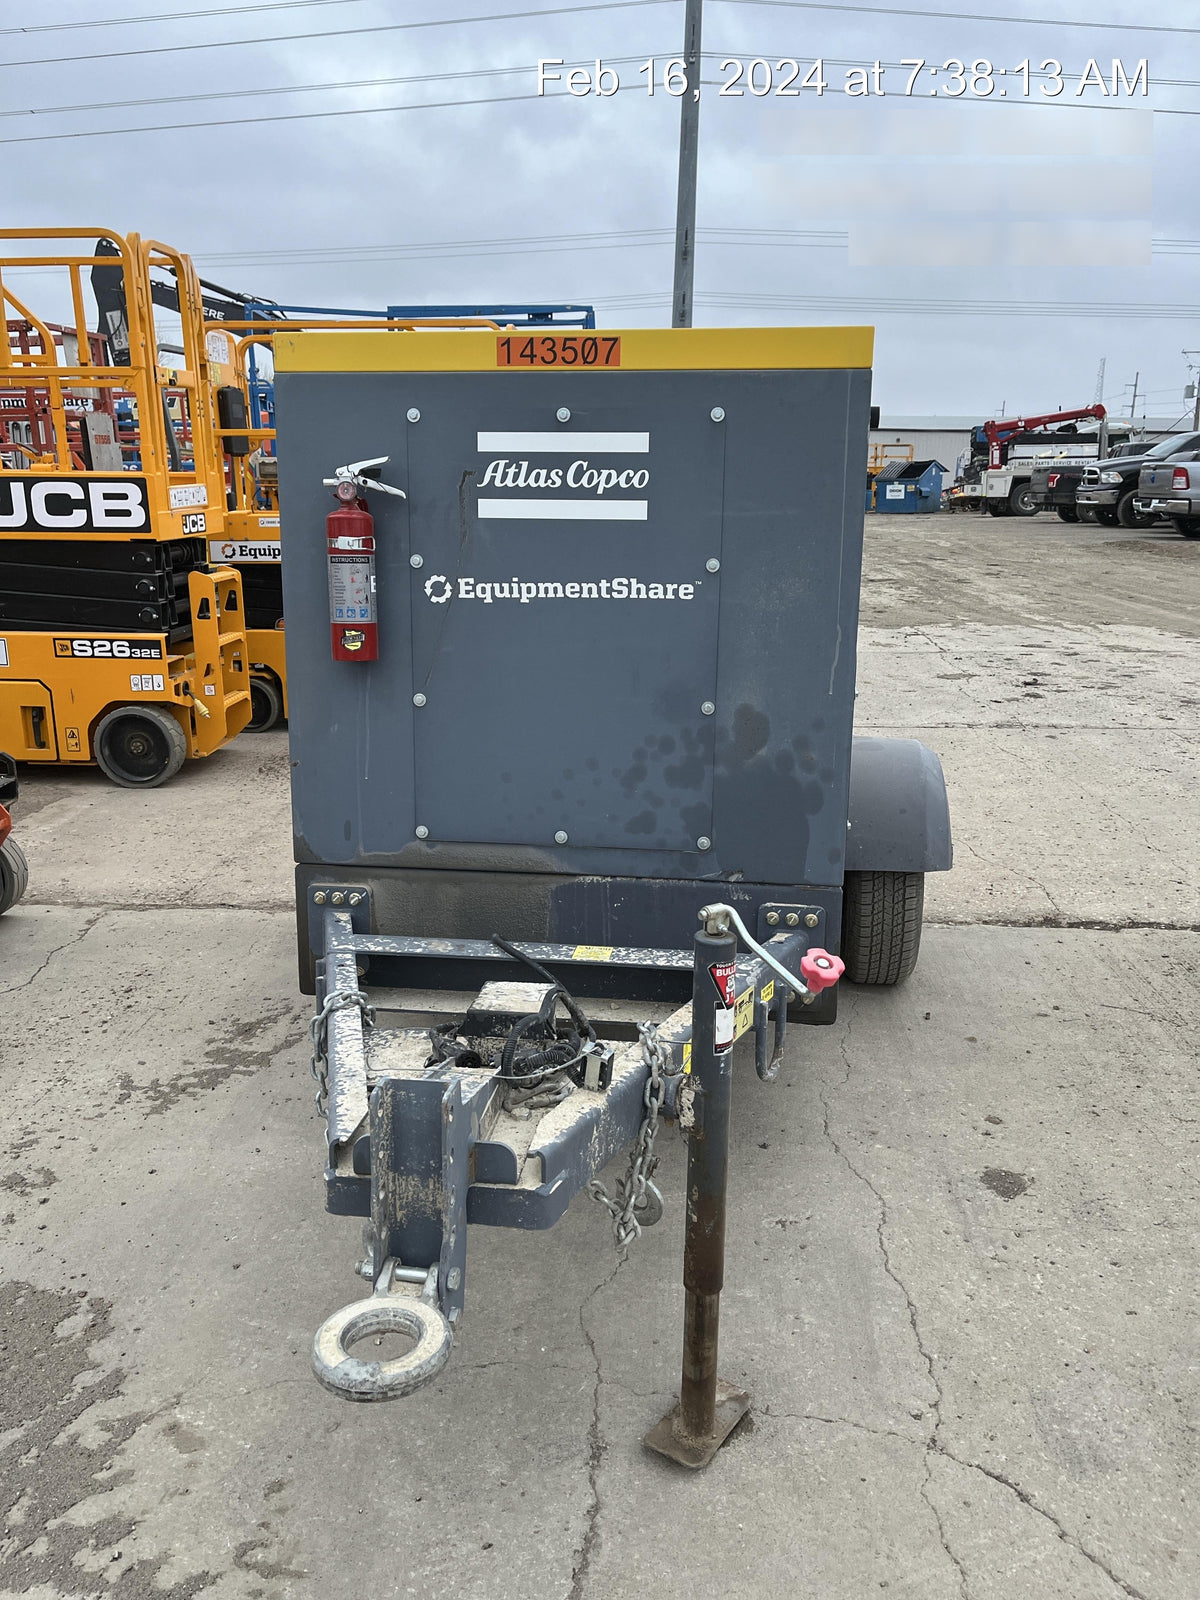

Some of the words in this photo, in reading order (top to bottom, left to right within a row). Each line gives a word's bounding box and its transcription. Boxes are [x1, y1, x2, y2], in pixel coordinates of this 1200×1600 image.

[500, 337, 619, 365] 143507
[477, 459, 563, 488] Atlas
[566, 460, 650, 494] Copco
[0, 481, 146, 528] JCB
[183, 514, 206, 534] JCB
